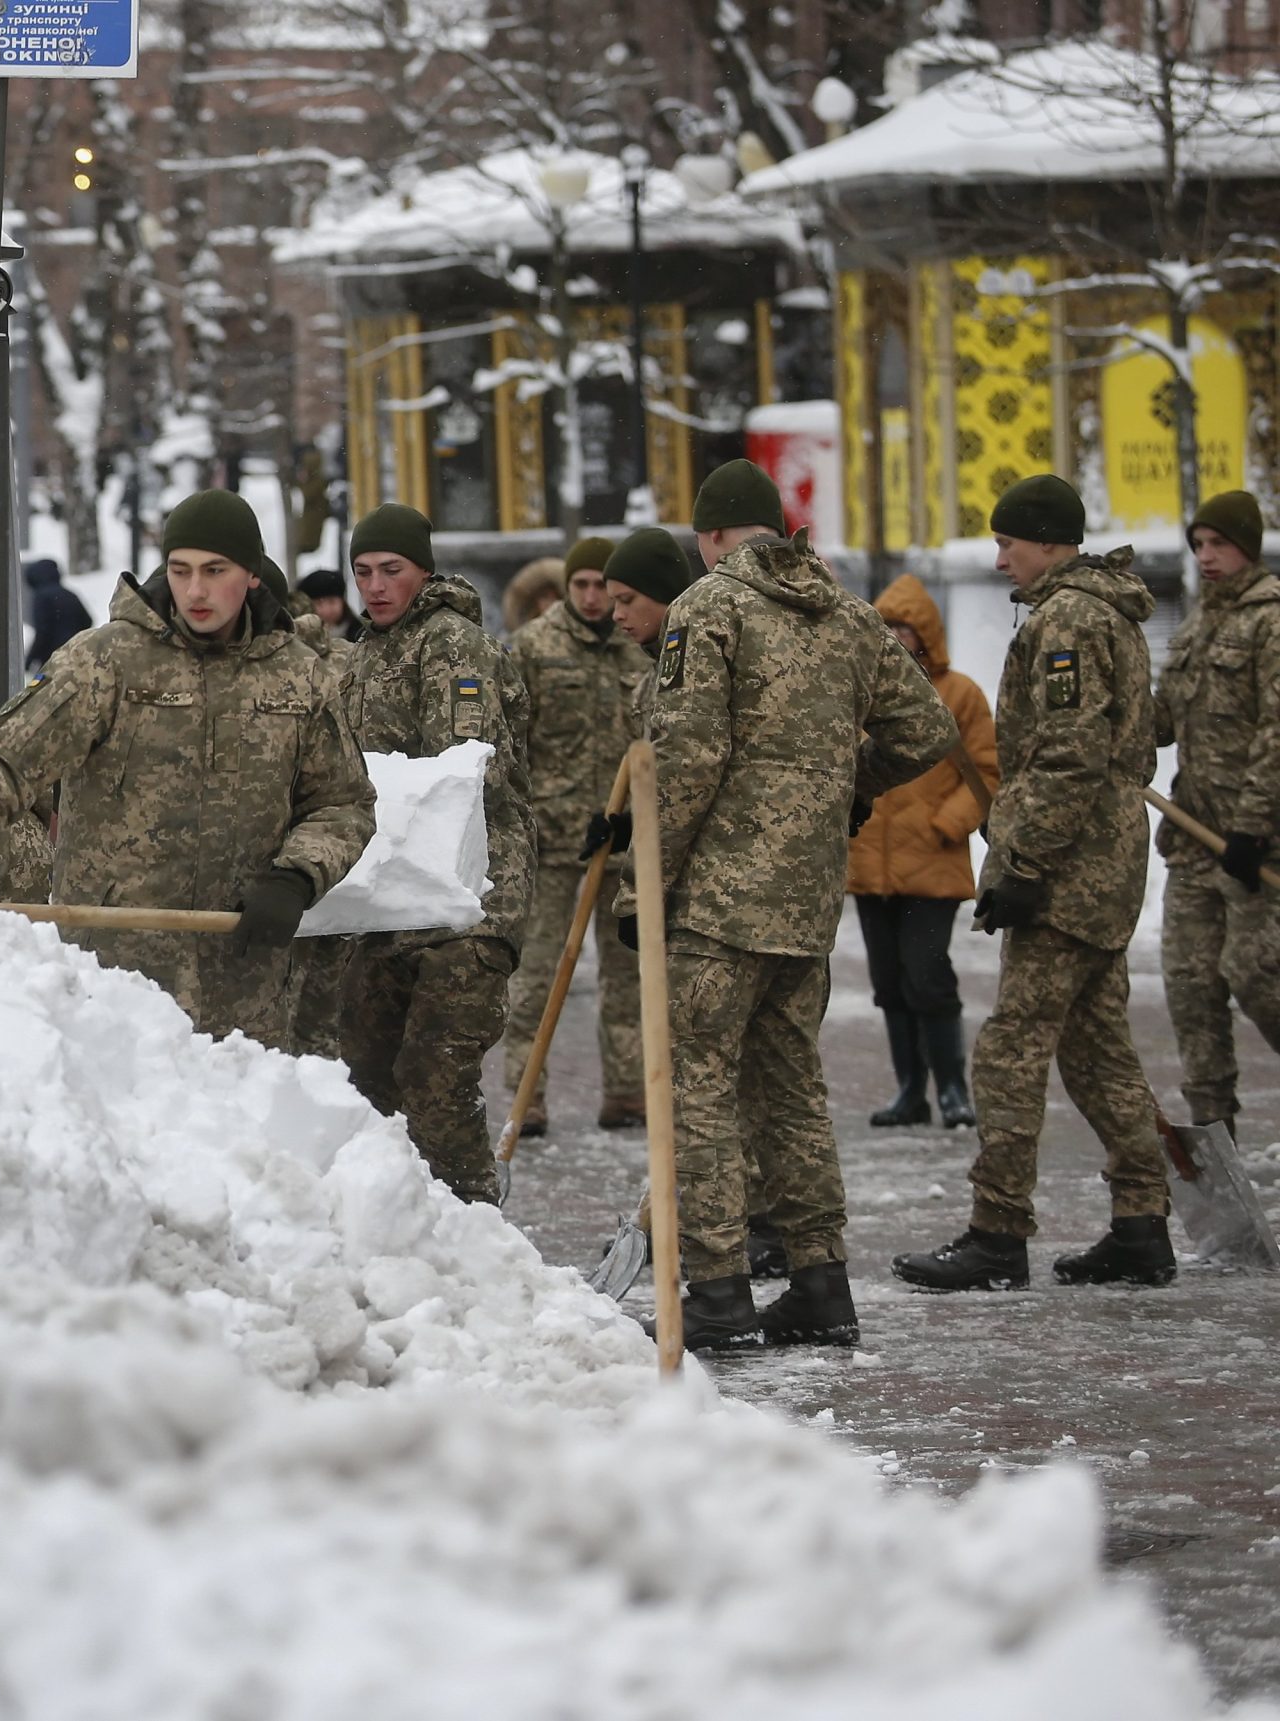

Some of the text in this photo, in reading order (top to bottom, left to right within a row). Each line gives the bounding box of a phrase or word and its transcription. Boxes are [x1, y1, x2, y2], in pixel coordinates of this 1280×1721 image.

[13, 3, 89, 16] зупинці
[7, 17, 82, 27] транспорту
[22, 27, 76, 36] навколо
